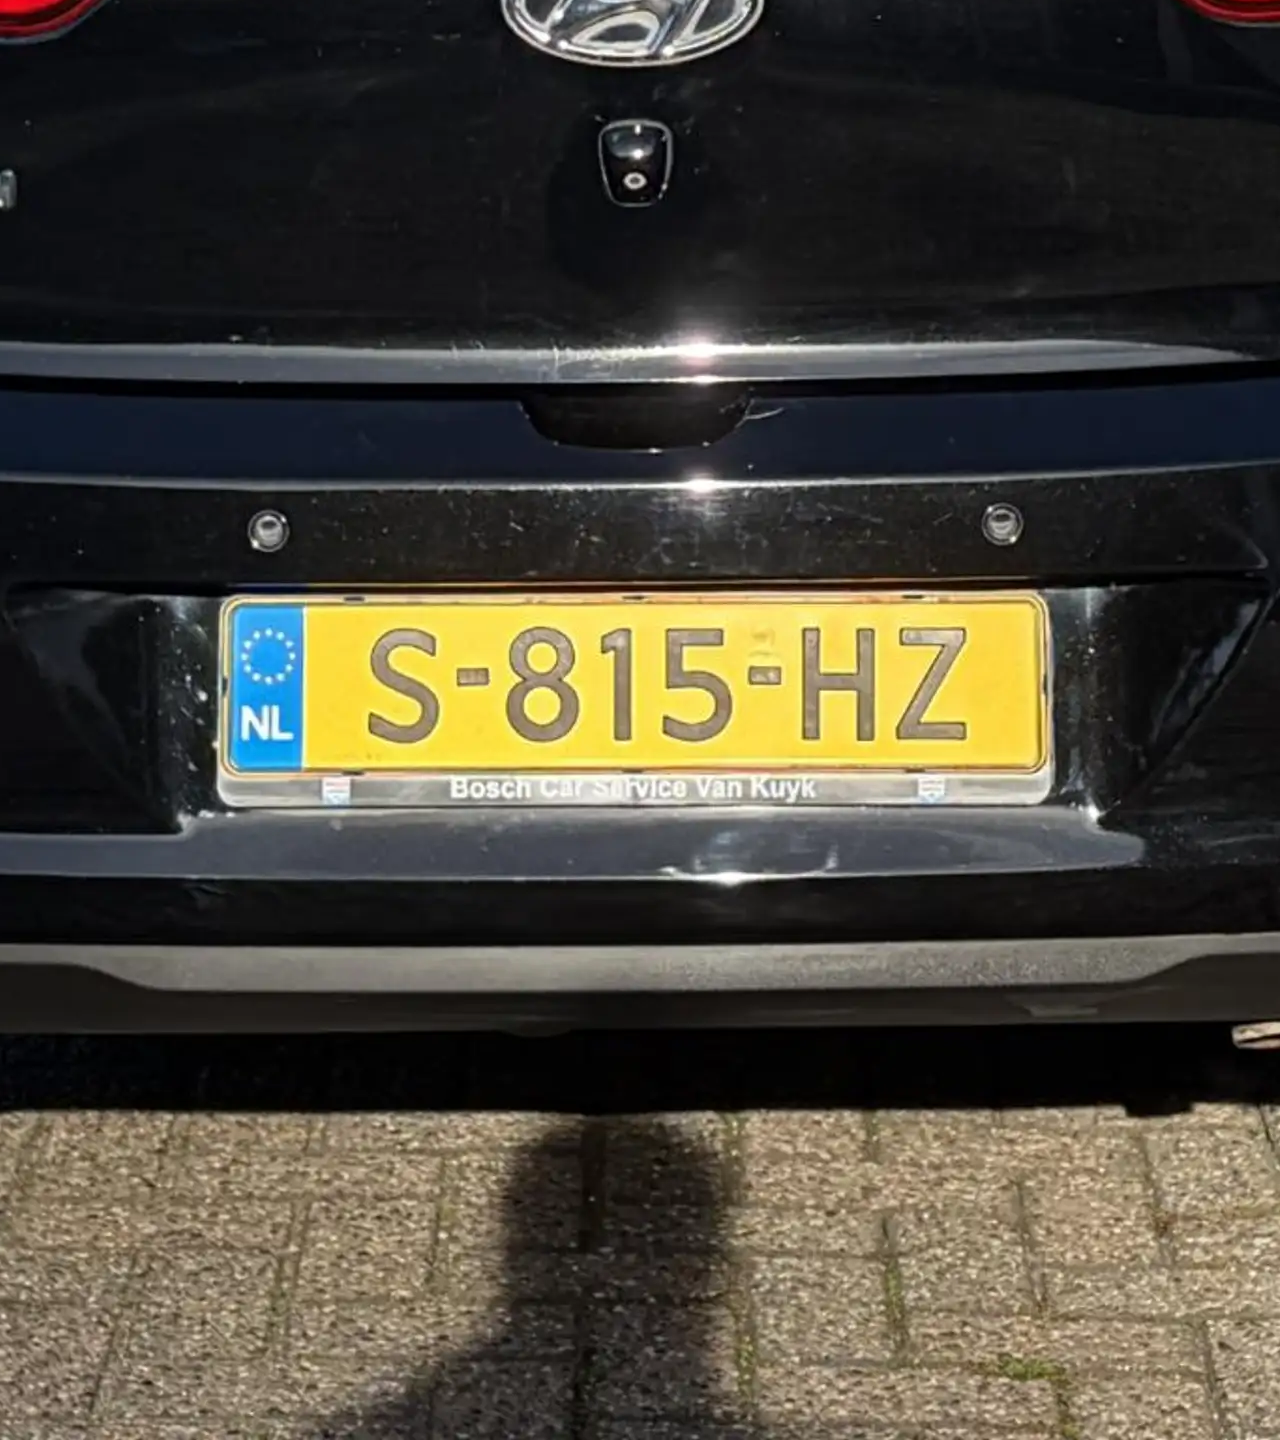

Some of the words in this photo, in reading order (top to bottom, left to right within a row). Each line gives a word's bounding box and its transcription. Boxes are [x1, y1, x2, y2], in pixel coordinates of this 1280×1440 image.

[367, 626, 968, 744] S-815-HZ
[240, 704, 295, 741] NL
[449, 775, 531, 799] Bosch
[540, 776, 582, 799] Car
[592, 776, 687, 799] Service
[696, 776, 742, 799] Van
[749, 776, 816, 803] Kuyk
